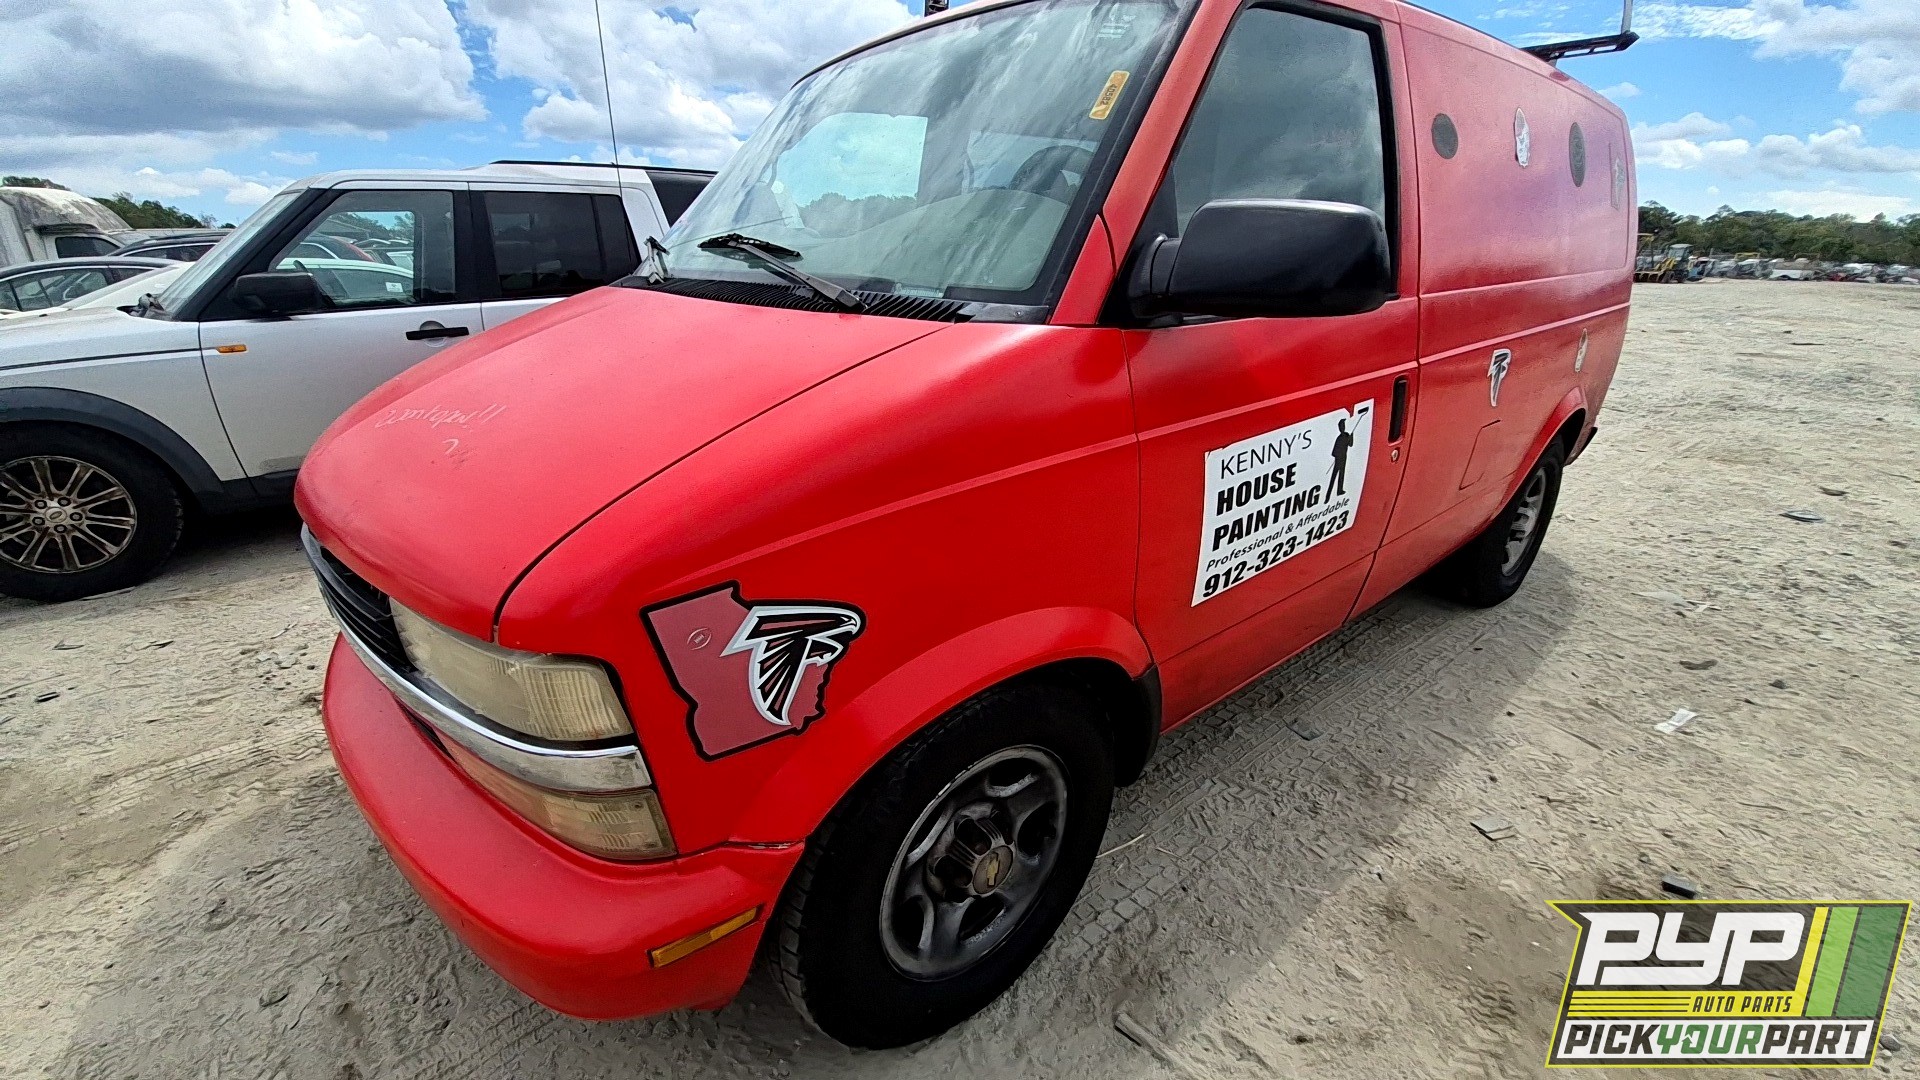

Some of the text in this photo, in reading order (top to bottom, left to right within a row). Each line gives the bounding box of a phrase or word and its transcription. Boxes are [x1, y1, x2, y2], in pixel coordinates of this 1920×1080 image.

[1100, 83, 1118, 106] 40582
[1220, 429, 1312, 480] KENNY'S
[1211, 484, 1322, 552] PAINTING
[1215, 462, 1298, 517] HOUSE
[1202, 510, 1350, 598] 912-323-1423
[1205, 497, 1350, 573] Professional & Affordable
